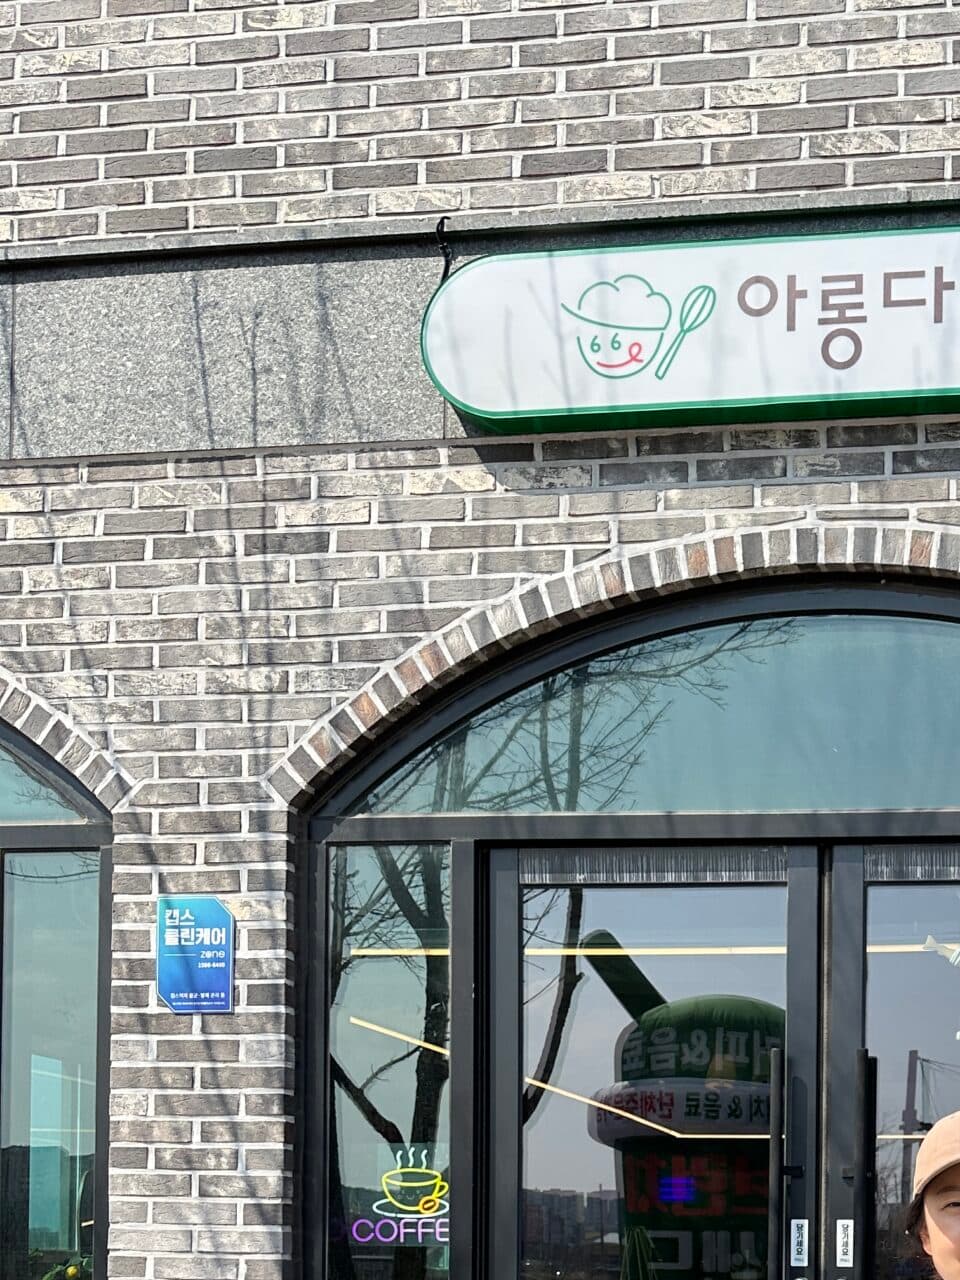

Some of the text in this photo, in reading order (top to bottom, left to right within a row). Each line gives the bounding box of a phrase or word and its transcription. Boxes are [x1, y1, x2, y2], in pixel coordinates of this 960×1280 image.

[165, 909, 196, 926] 캡스
[165, 928, 226, 946] 클린케어
[796, 1223, 804, 1256] 당기세요
[841, 1223, 849, 1256] 당기세요
